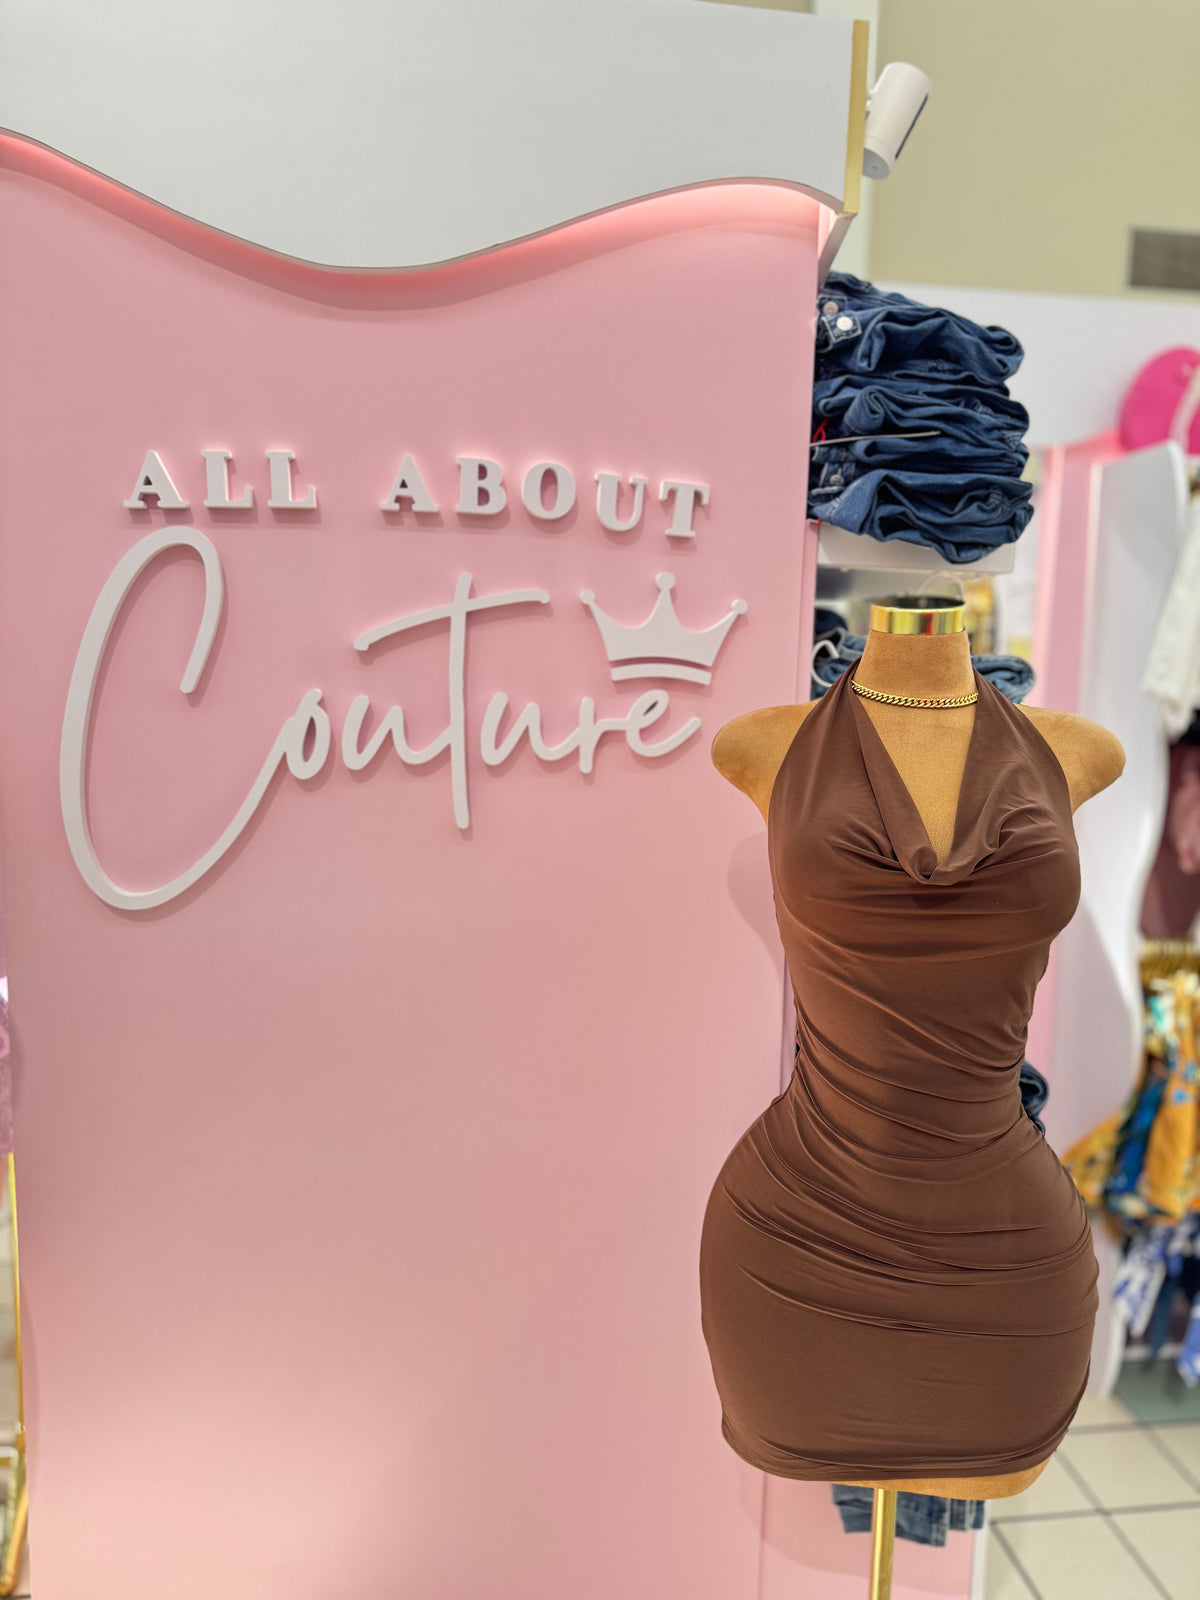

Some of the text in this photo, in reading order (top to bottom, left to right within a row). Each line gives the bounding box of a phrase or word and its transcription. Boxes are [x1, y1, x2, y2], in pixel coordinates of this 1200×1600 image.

[123, 449, 710, 538] ALL ABOUT
[59, 525, 702, 911] Couture
